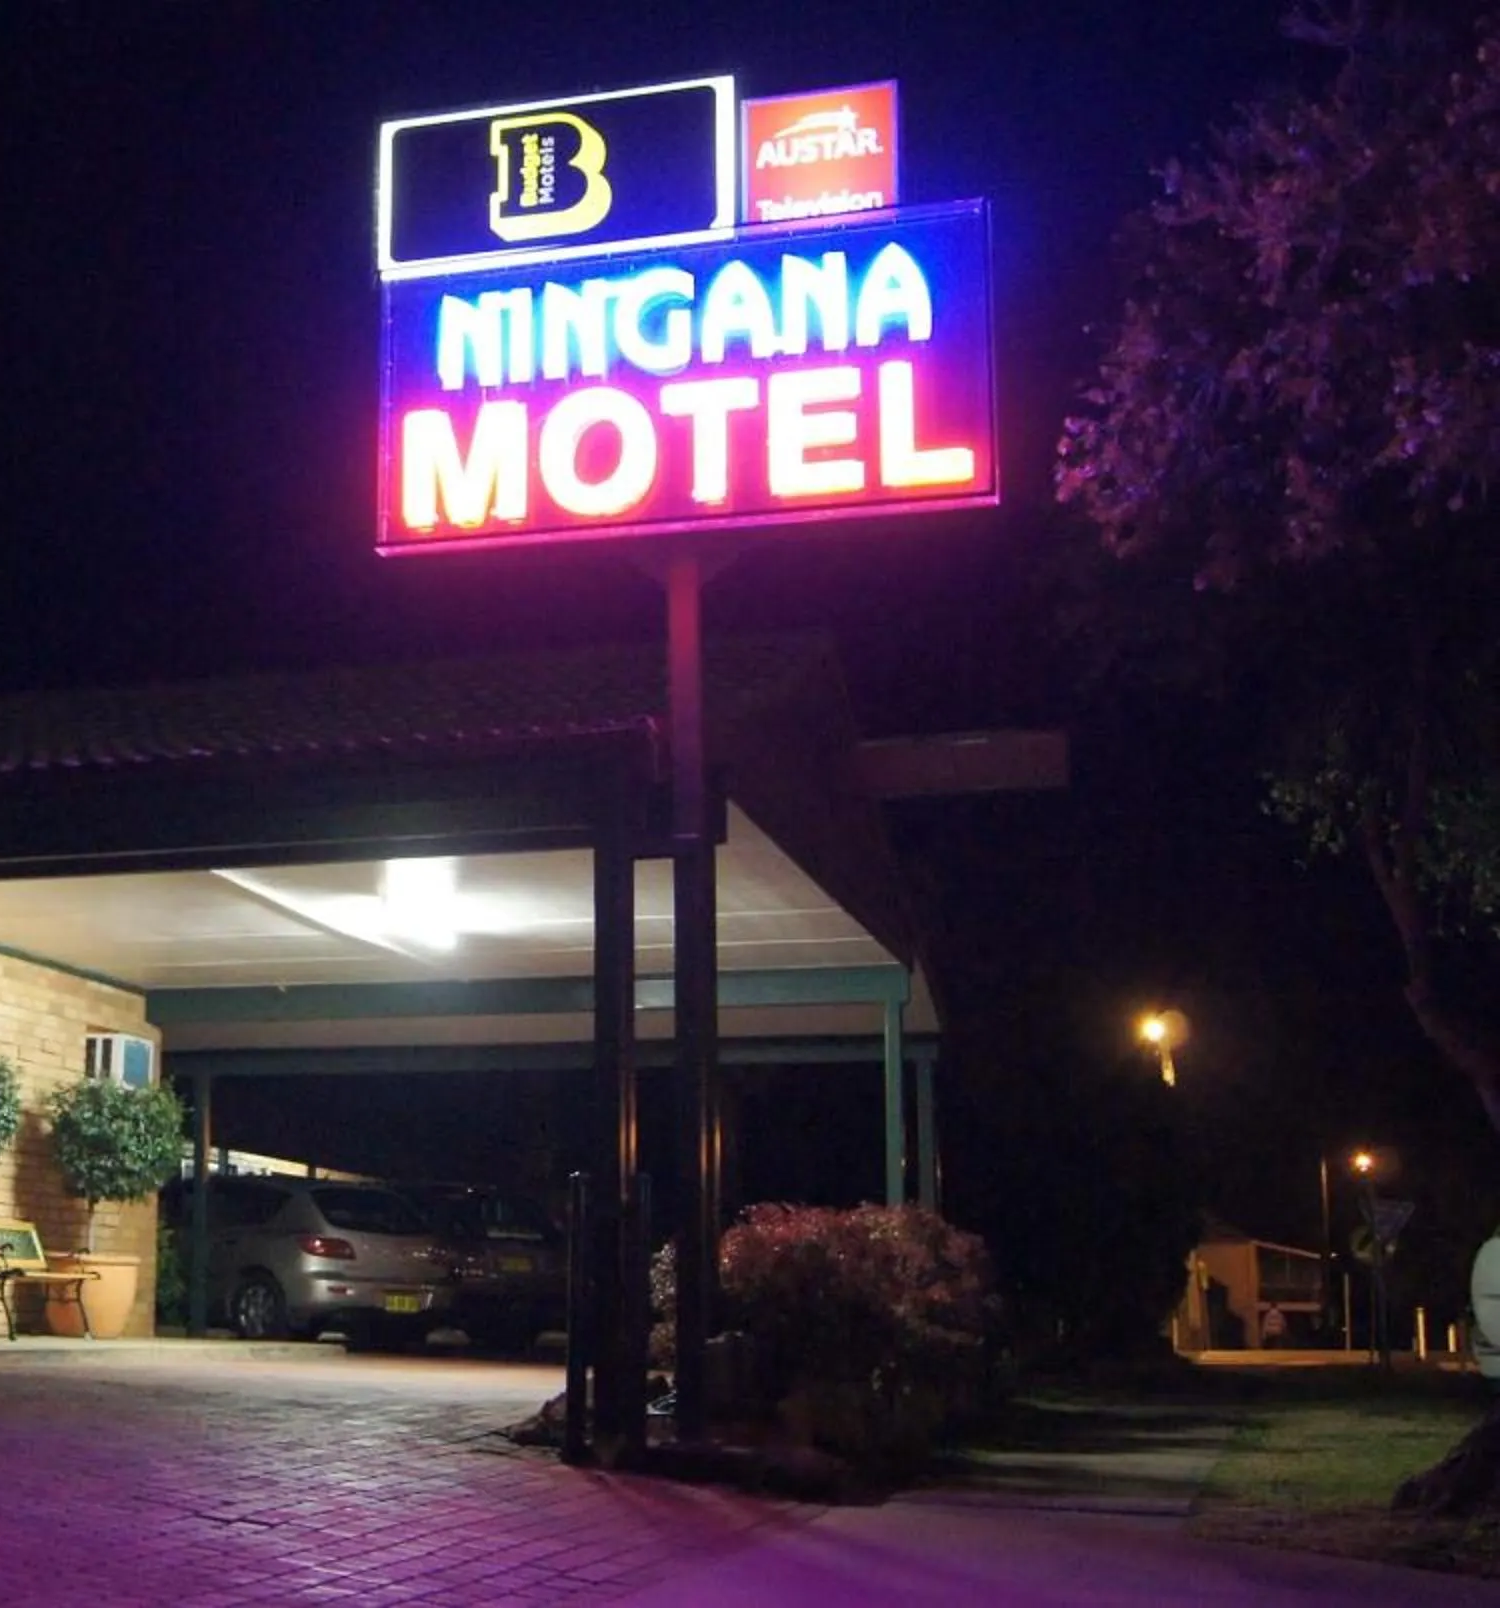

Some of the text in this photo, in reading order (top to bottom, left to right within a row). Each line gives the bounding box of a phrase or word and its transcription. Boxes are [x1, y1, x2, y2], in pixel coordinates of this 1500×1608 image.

[490, 112, 612, 242] B
[539, 137, 554, 203] Motels
[756, 190, 884, 222] Television
[437, 242, 932, 390] NINGANA
[402, 361, 974, 530] MOTEL
